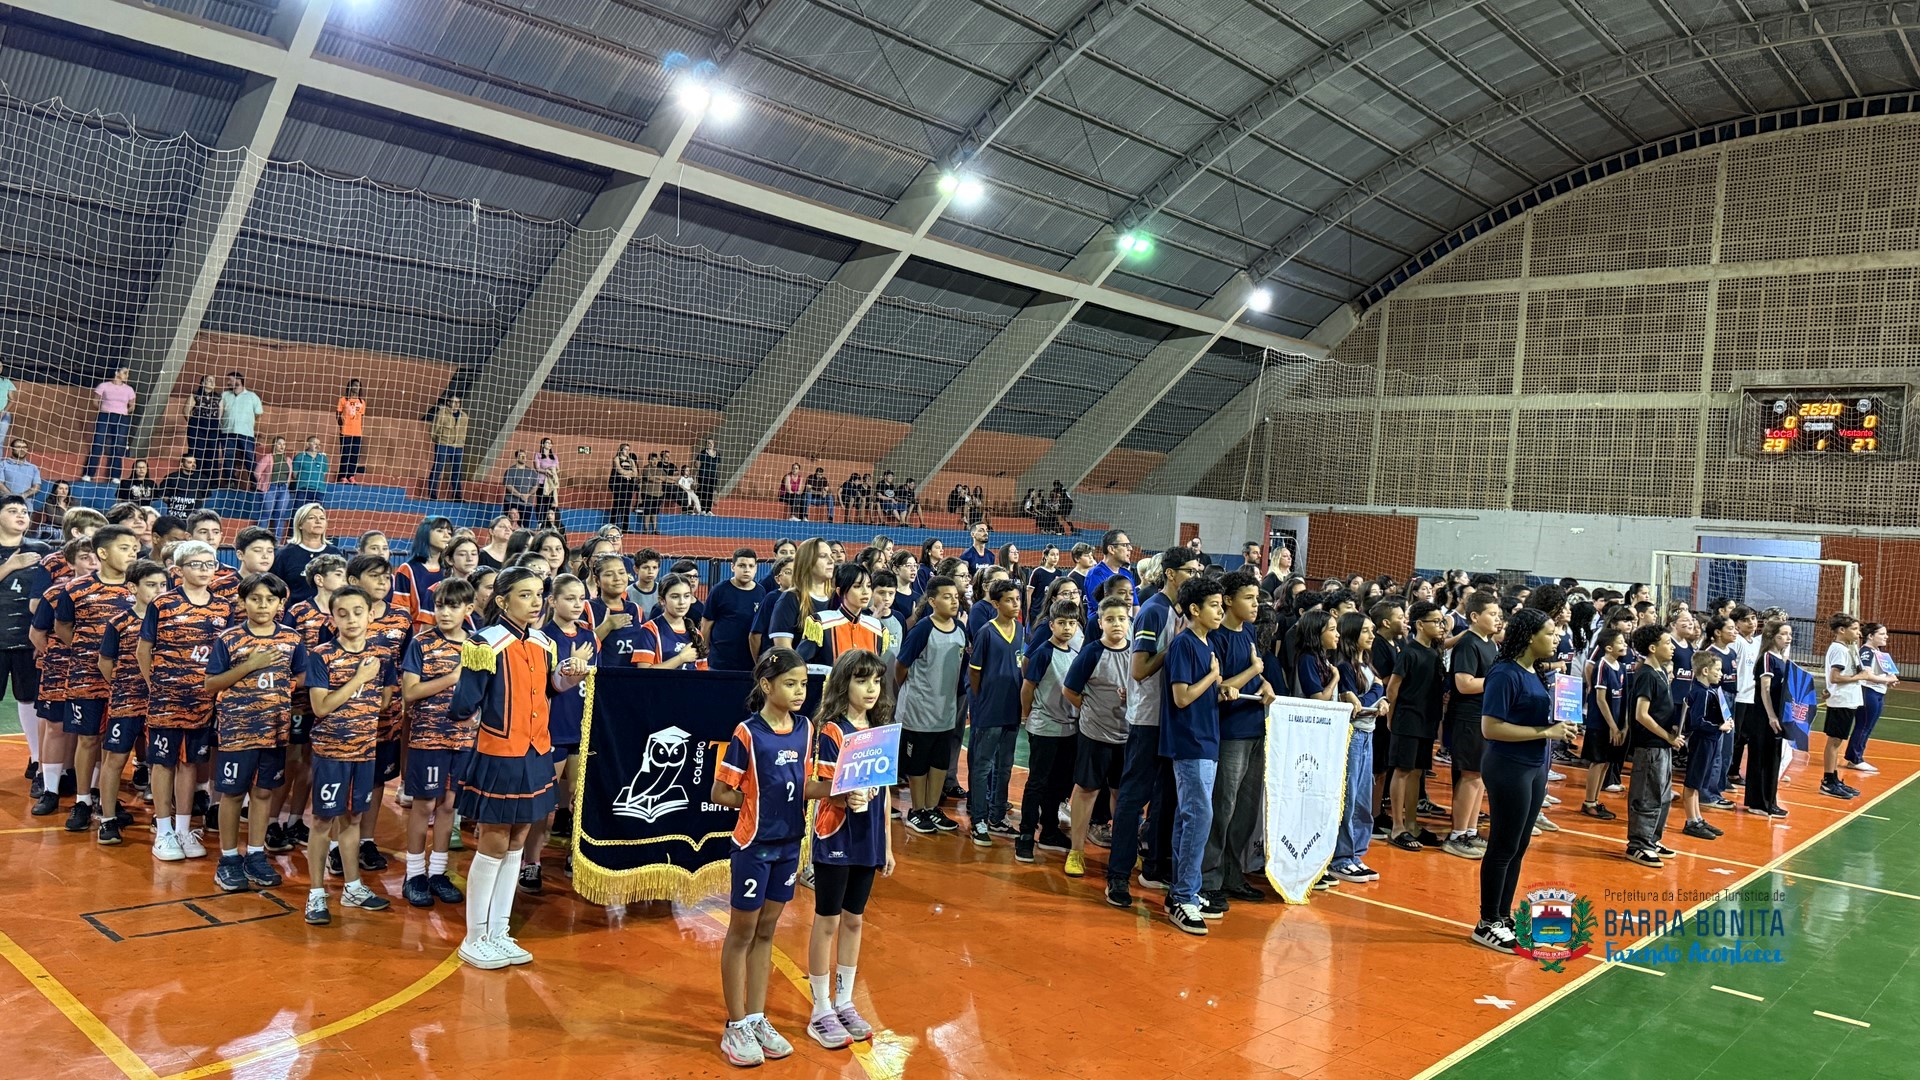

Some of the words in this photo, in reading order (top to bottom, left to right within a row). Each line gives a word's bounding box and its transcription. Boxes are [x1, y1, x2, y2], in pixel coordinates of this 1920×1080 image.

[1799, 403, 1843, 416] 26:30
[1784, 415, 1796, 428] 0
[1863, 415, 1877, 428] 0
[1766, 429, 1798, 438] Local
[1839, 429, 1874, 437] Visitante
[1763, 438, 1787, 450] 29
[1851, 438, 1876, 450] 27
[10, 579, 22, 593] 4
[190, 645, 209, 662] 42
[616, 640, 634, 655] 25
[257, 672, 275, 689] 61
[292, 714, 303, 728] 9
[111, 723, 121, 738] 6
[154, 734, 169, 754] 42
[852, 747, 883, 760] COLÉGIO
[223, 761, 239, 779] 61
[693, 741, 706, 785] COLÉGIO
[843, 756, 890, 780] TYTO
[426, 766, 439, 783] 11
[320, 783, 341, 801] 67
[786, 781, 796, 802] 2
[1280, 834, 1299, 860] BARRA
[743, 878, 758, 898] 2
